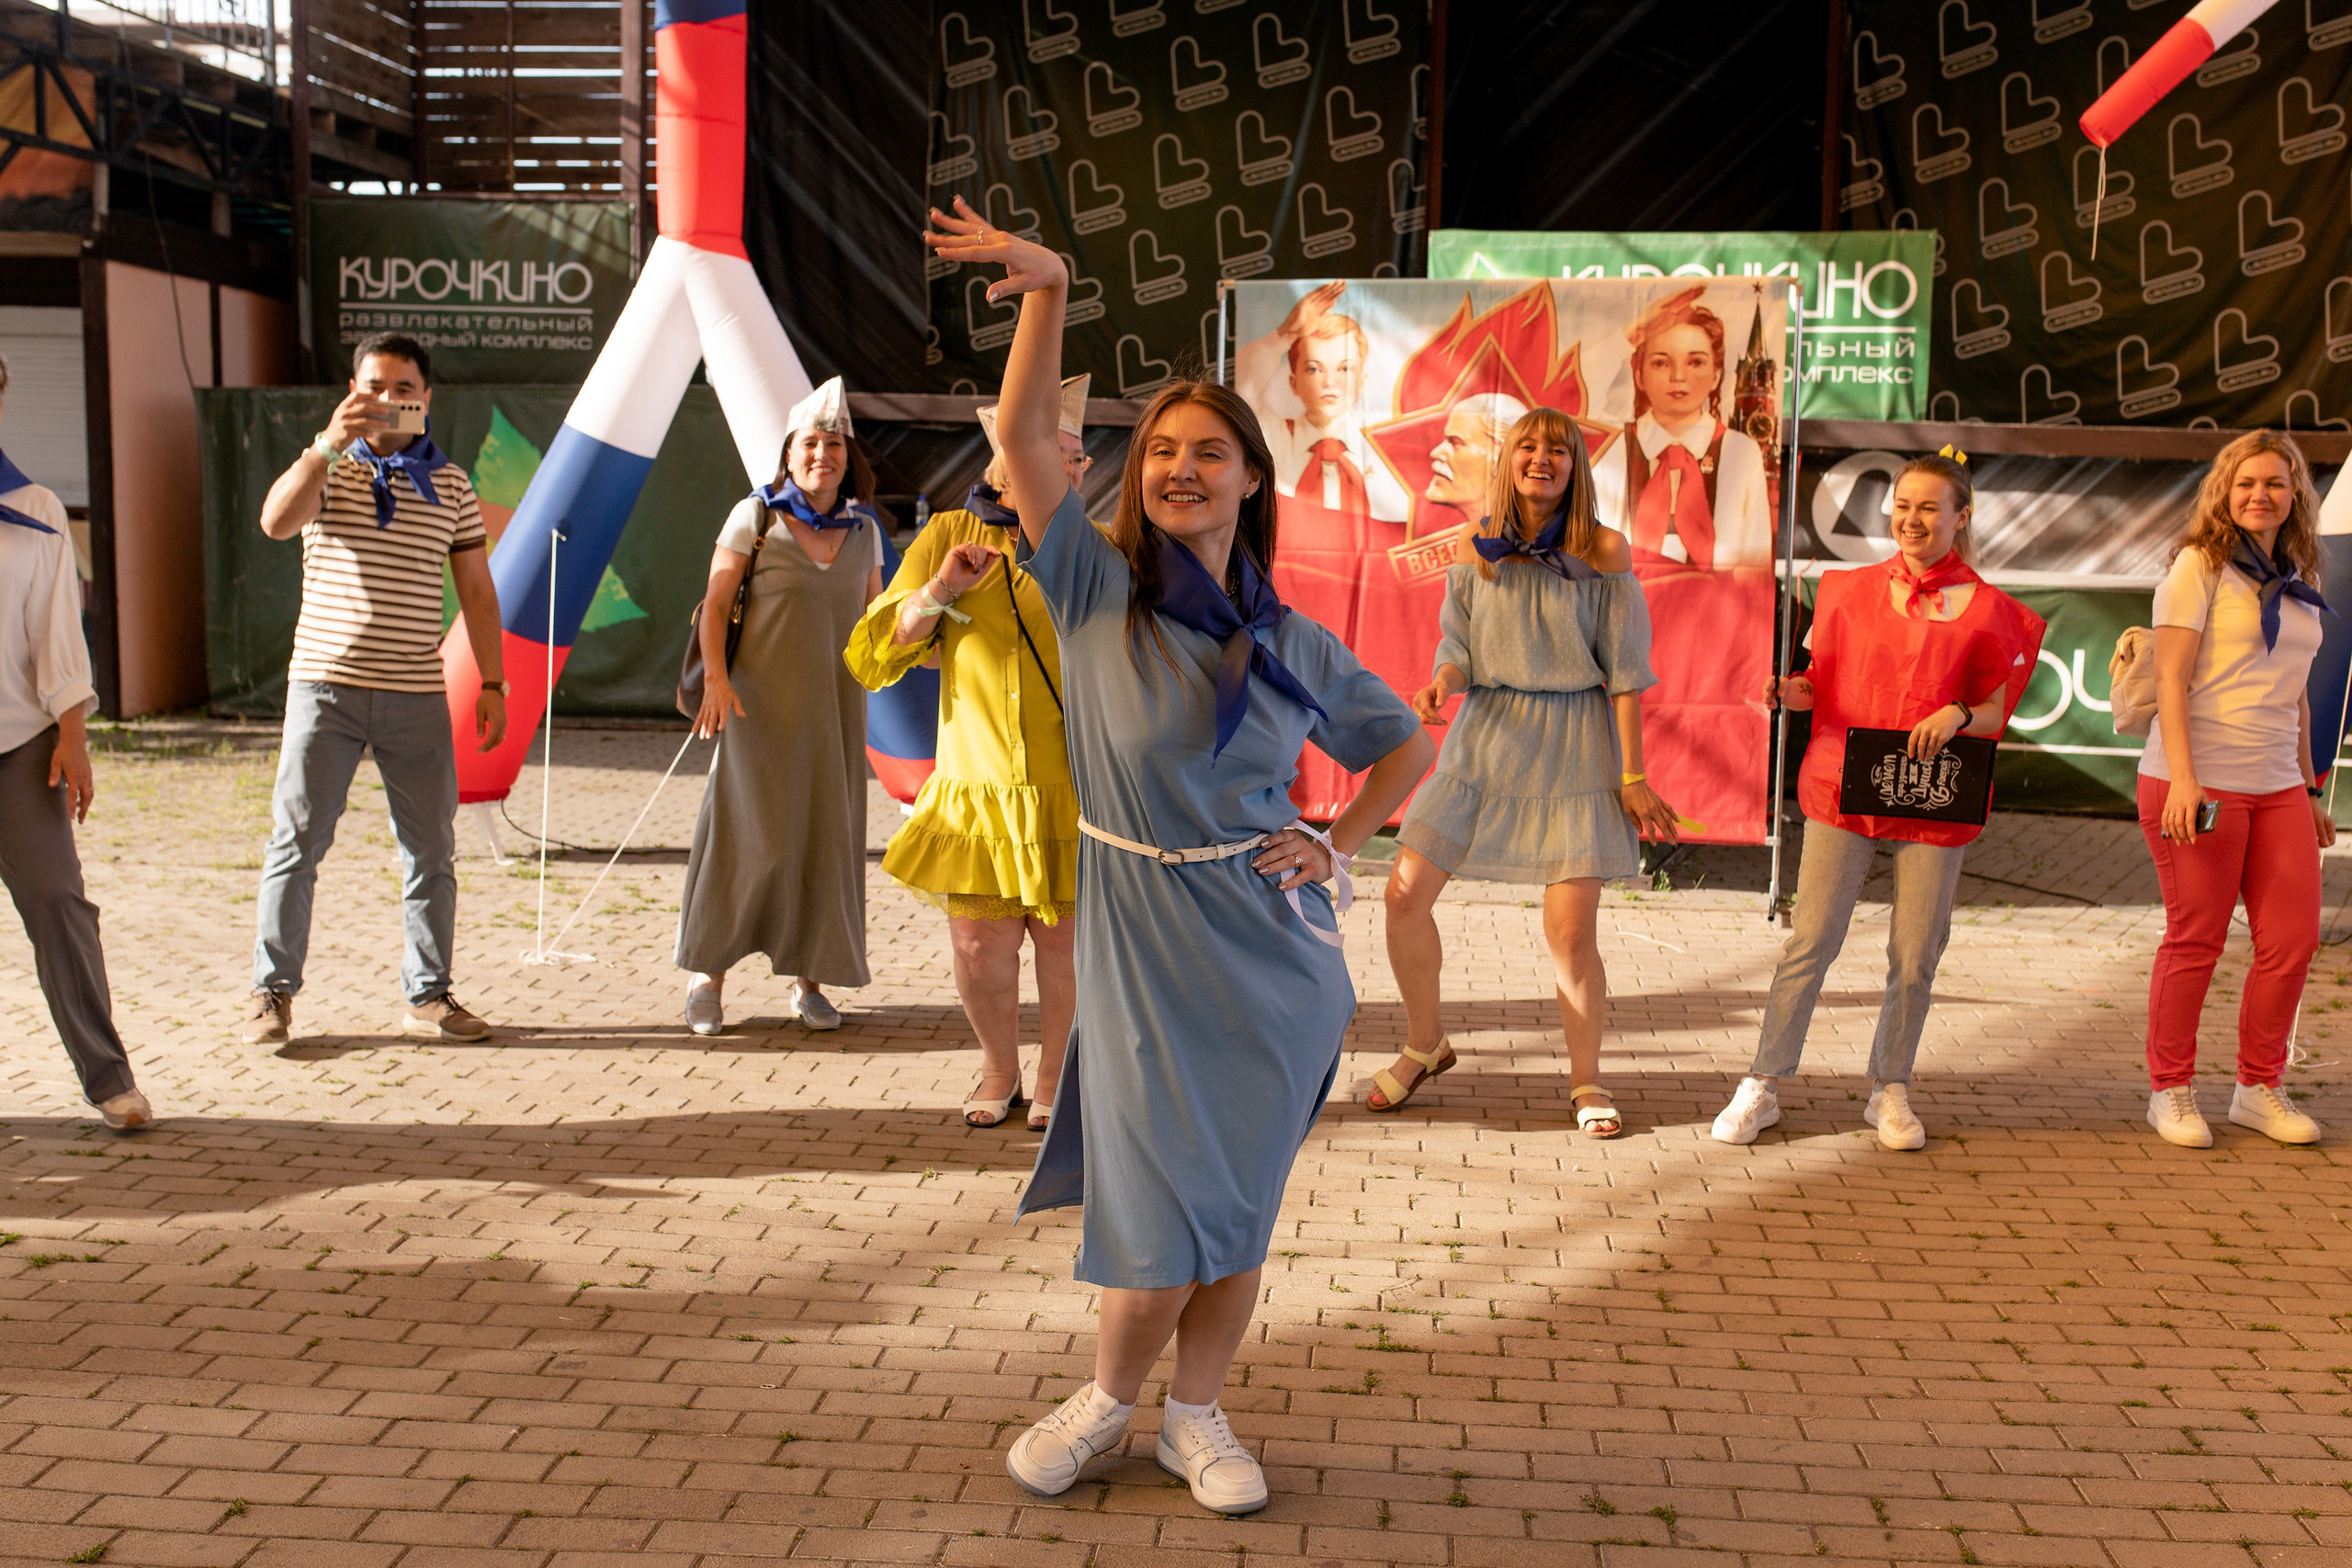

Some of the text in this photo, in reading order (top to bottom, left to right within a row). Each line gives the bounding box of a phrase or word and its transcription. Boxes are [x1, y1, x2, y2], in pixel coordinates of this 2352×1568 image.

[339, 256, 594, 304] КУРОЧКИНО
[339, 312, 593, 332] развлекательный
[340, 330, 593, 350] задный комплекс
[1783, 366, 1914, 384] омплекс
[1406, 541, 1457, 575] ВСЕГ
